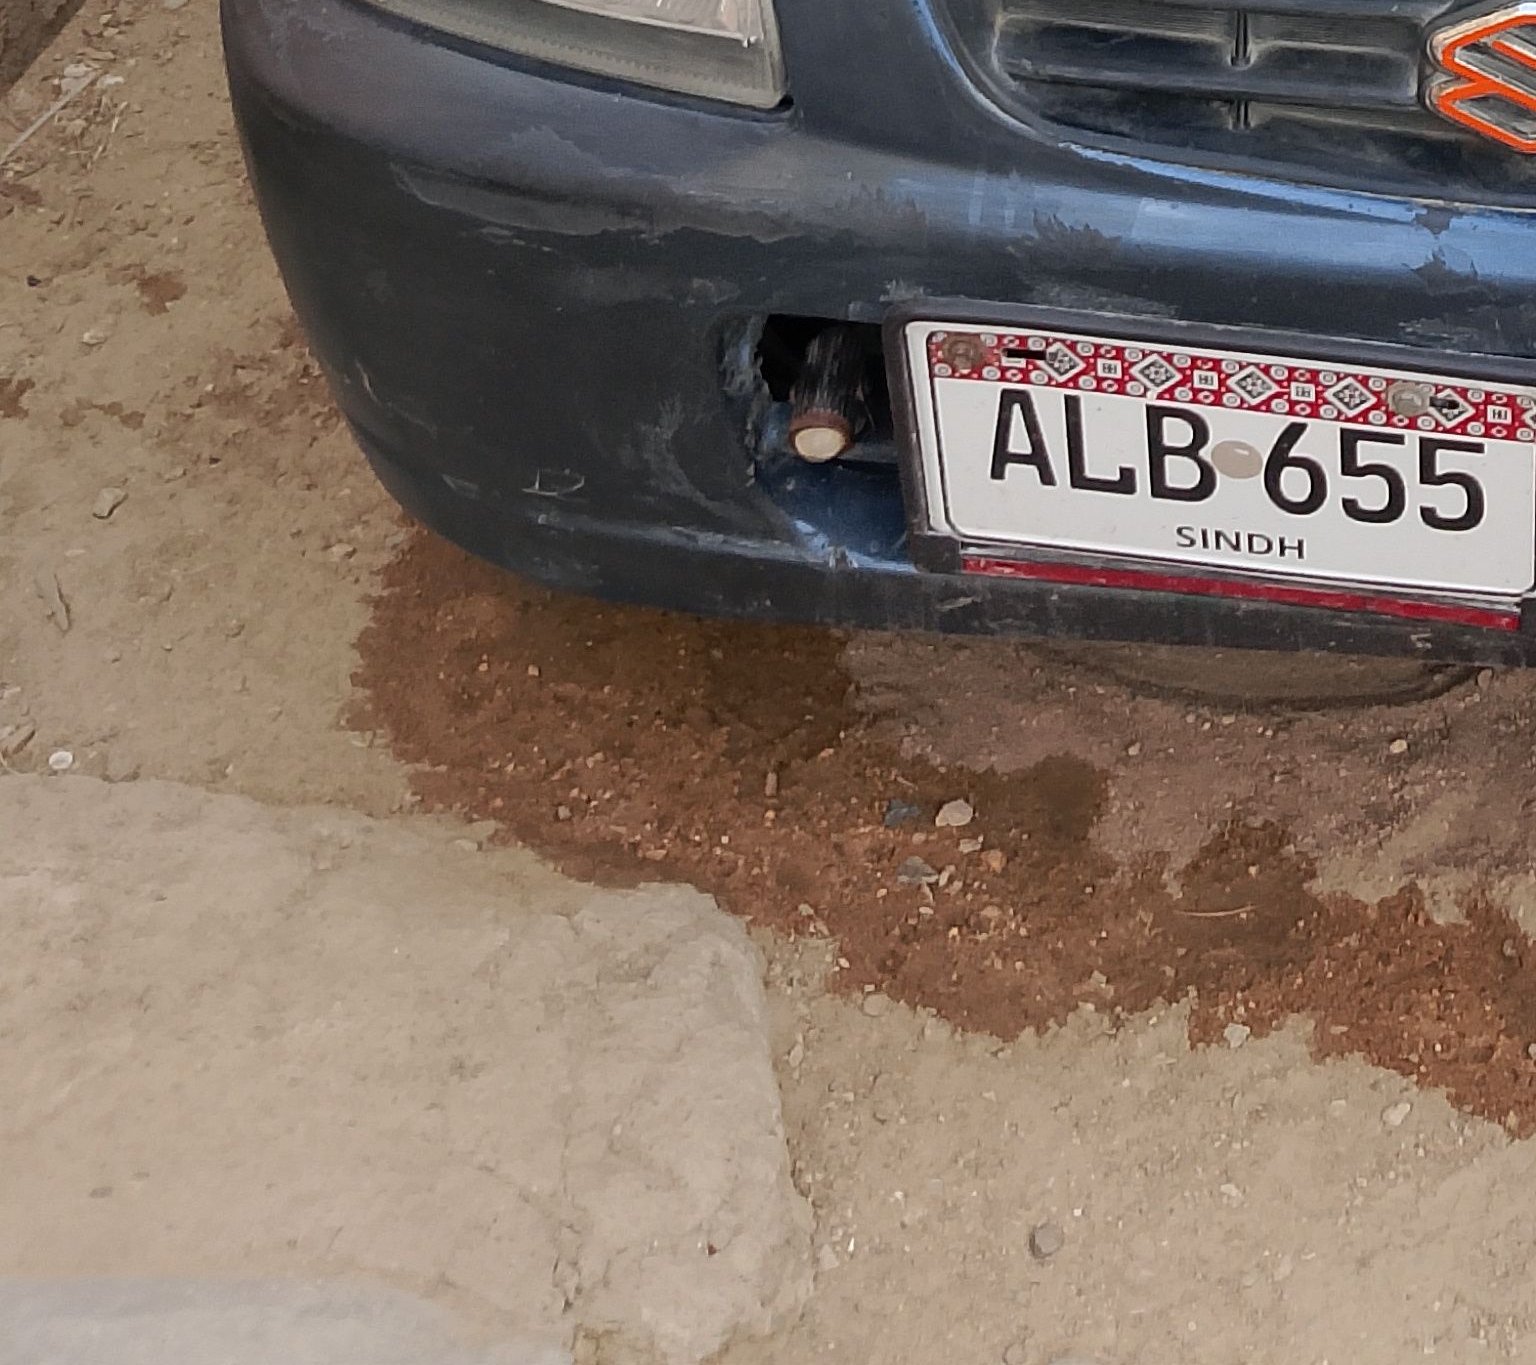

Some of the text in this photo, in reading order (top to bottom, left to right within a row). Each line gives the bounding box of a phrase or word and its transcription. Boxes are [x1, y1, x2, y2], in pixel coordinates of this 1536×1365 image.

[990, 387, 1487, 533] ALB 655
[1175, 525, 1306, 561] SINDH
